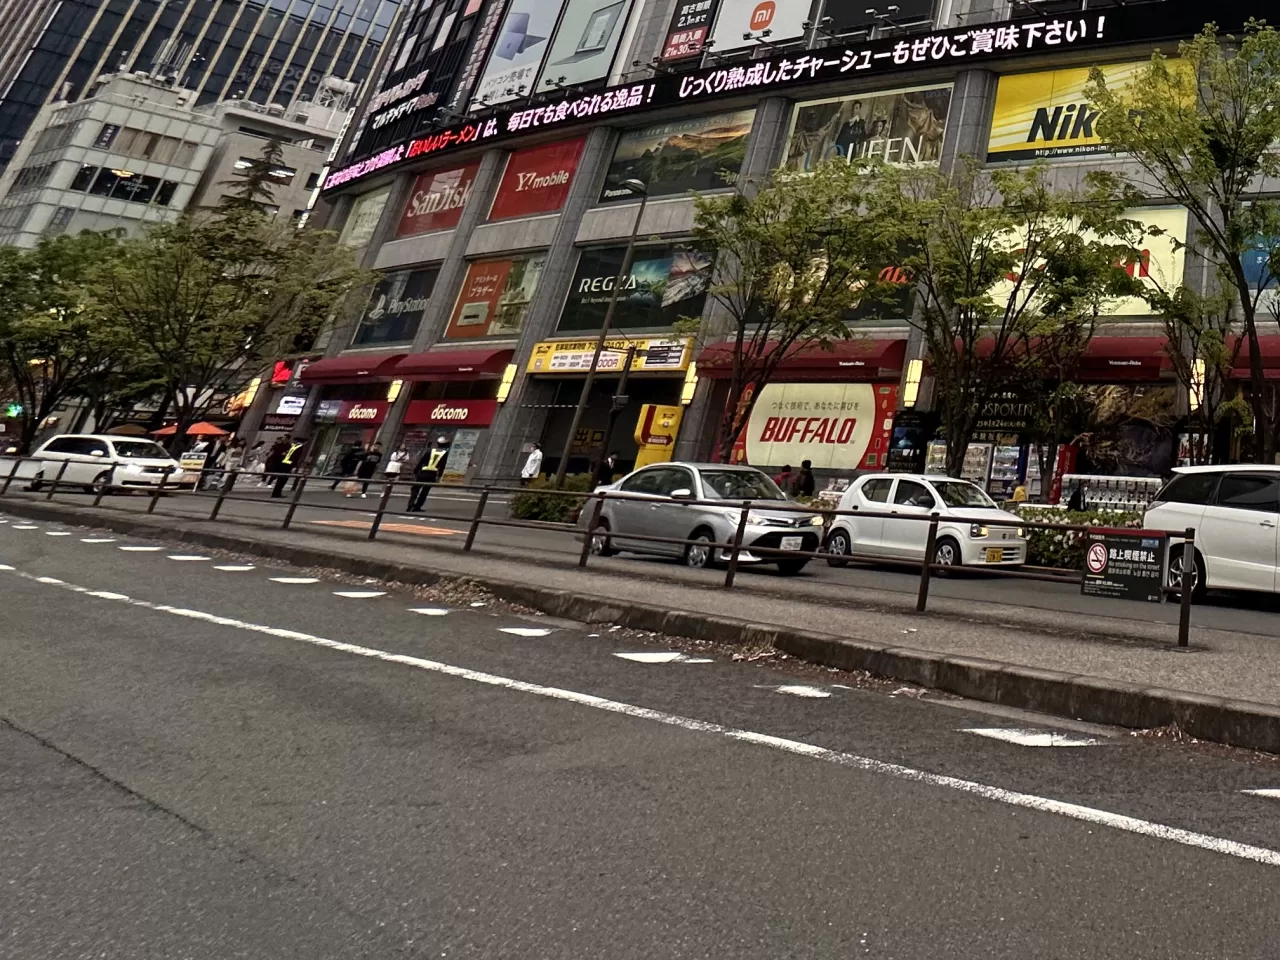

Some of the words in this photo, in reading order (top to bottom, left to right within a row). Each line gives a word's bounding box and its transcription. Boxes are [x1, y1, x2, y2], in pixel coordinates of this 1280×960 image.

[516, 169, 570, 194] Y!mobile
[406, 180, 472, 218] SanDisk
[349, 405, 377, 419] docomo
[431, 405, 468, 420] docomo
[760, 417, 856, 444] BUFFALO
[1109, 548, 1155, 562] 路上喫煙禁止
